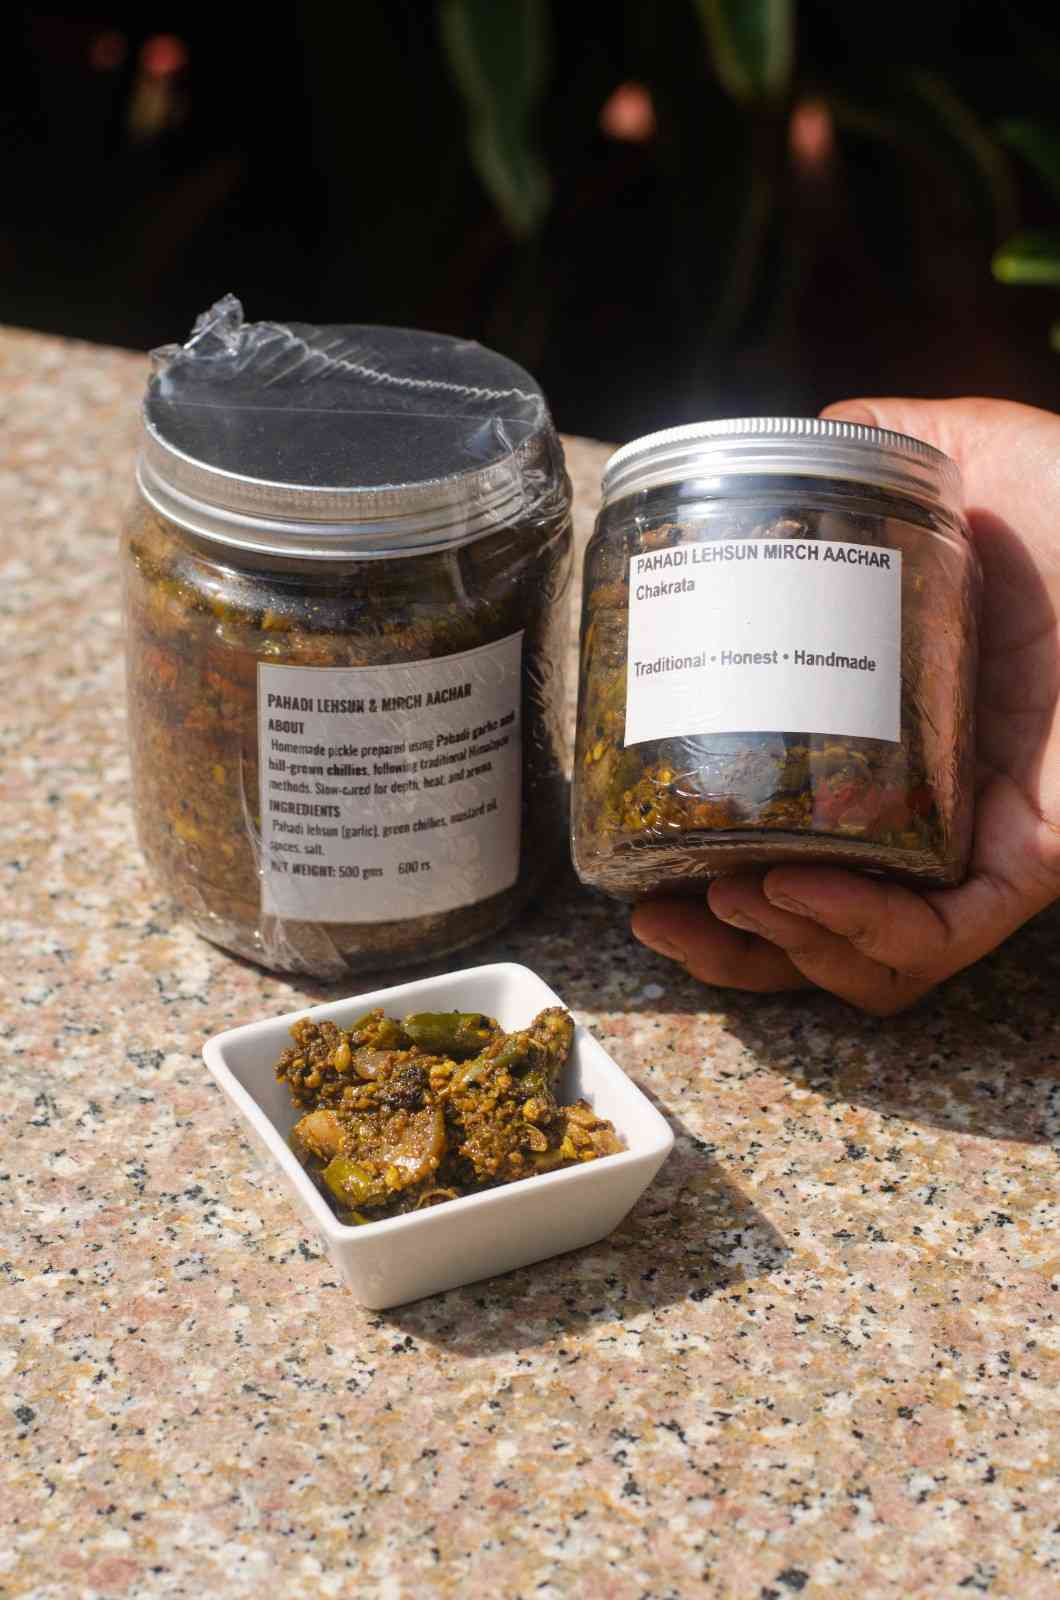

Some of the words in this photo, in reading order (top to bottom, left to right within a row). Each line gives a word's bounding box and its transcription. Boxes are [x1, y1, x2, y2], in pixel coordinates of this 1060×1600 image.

[636, 549, 688, 576] PAHADI
[692, 544, 758, 564] LEHSUN
[764, 543, 819, 561] MIRCH
[823, 546, 891, 570] AACHAR
[636, 577, 696, 601] Chakrata
[634, 650, 706, 677] Traditional
[721, 650, 778, 665] Honest
[794, 649, 876, 672] Handmade
[267, 693, 314, 713] PAHADI
[368, 698, 378, 713] &
[381, 694, 422, 712] MIRCH
[425, 683, 472, 706] AACHAR
[268, 718, 305, 735] ABOUT
[271, 738, 325, 756] Homemade
[328, 743, 358, 759] pickle
[360, 741, 405, 759] prepared
[436, 727, 470, 748] Pahadi
[268, 756, 323, 777] hill-grown
[420, 748, 467, 770] traditional
[315, 782, 370, 797] Slow-cured
[373, 783, 387, 796] for
[447, 768, 465, 784] and
[269, 799, 341, 819] INGREDIENTS
[272, 819, 304, 836] Pahadi
[306, 824, 338, 837] lehsun
[383, 823, 410, 839] green
[292, 863, 336, 878] WEIGHT:
[338, 865, 360, 878] 500
[420, 861, 431, 872] rs
